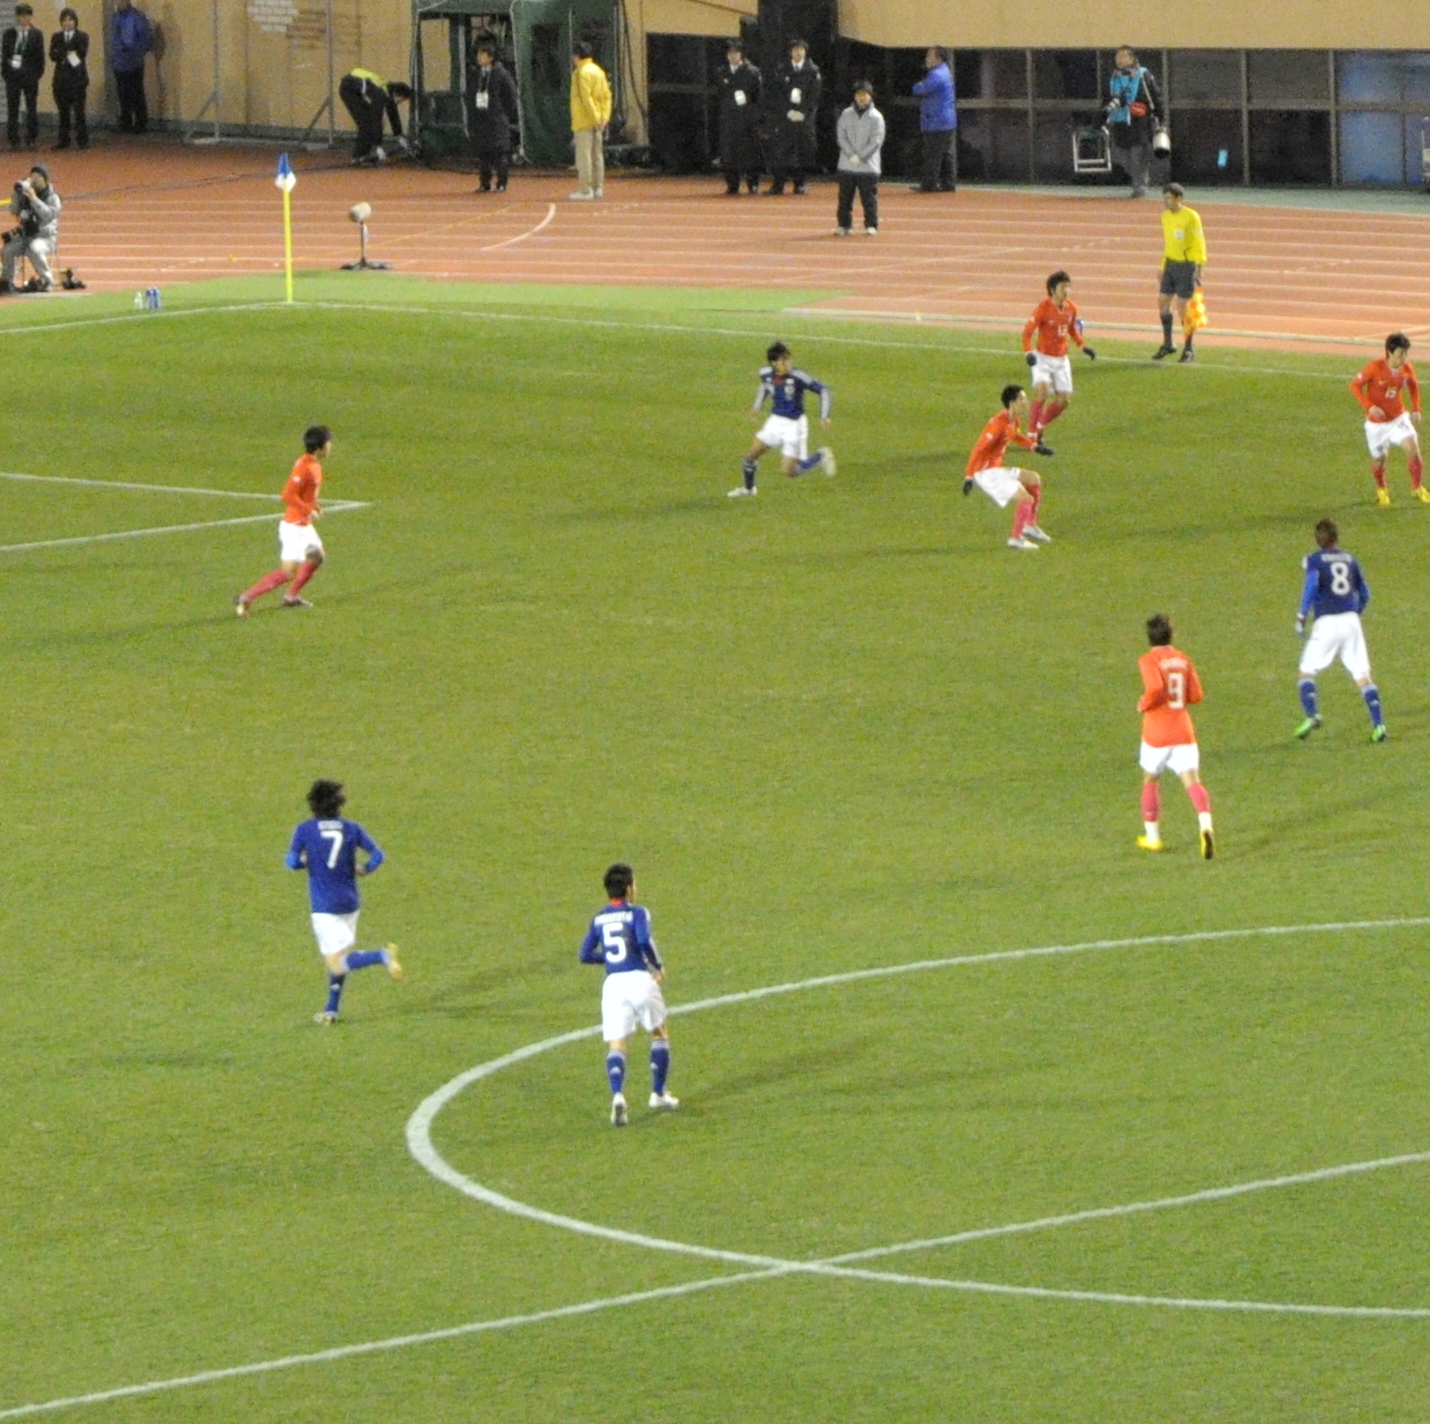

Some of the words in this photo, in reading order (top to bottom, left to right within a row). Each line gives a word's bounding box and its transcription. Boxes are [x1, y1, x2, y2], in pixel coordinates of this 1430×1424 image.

[1330, 561, 1351, 596] 8
[1168, 672, 1185, 709] 9
[320, 830, 344, 869] 7
[602, 922, 627, 964] 5
